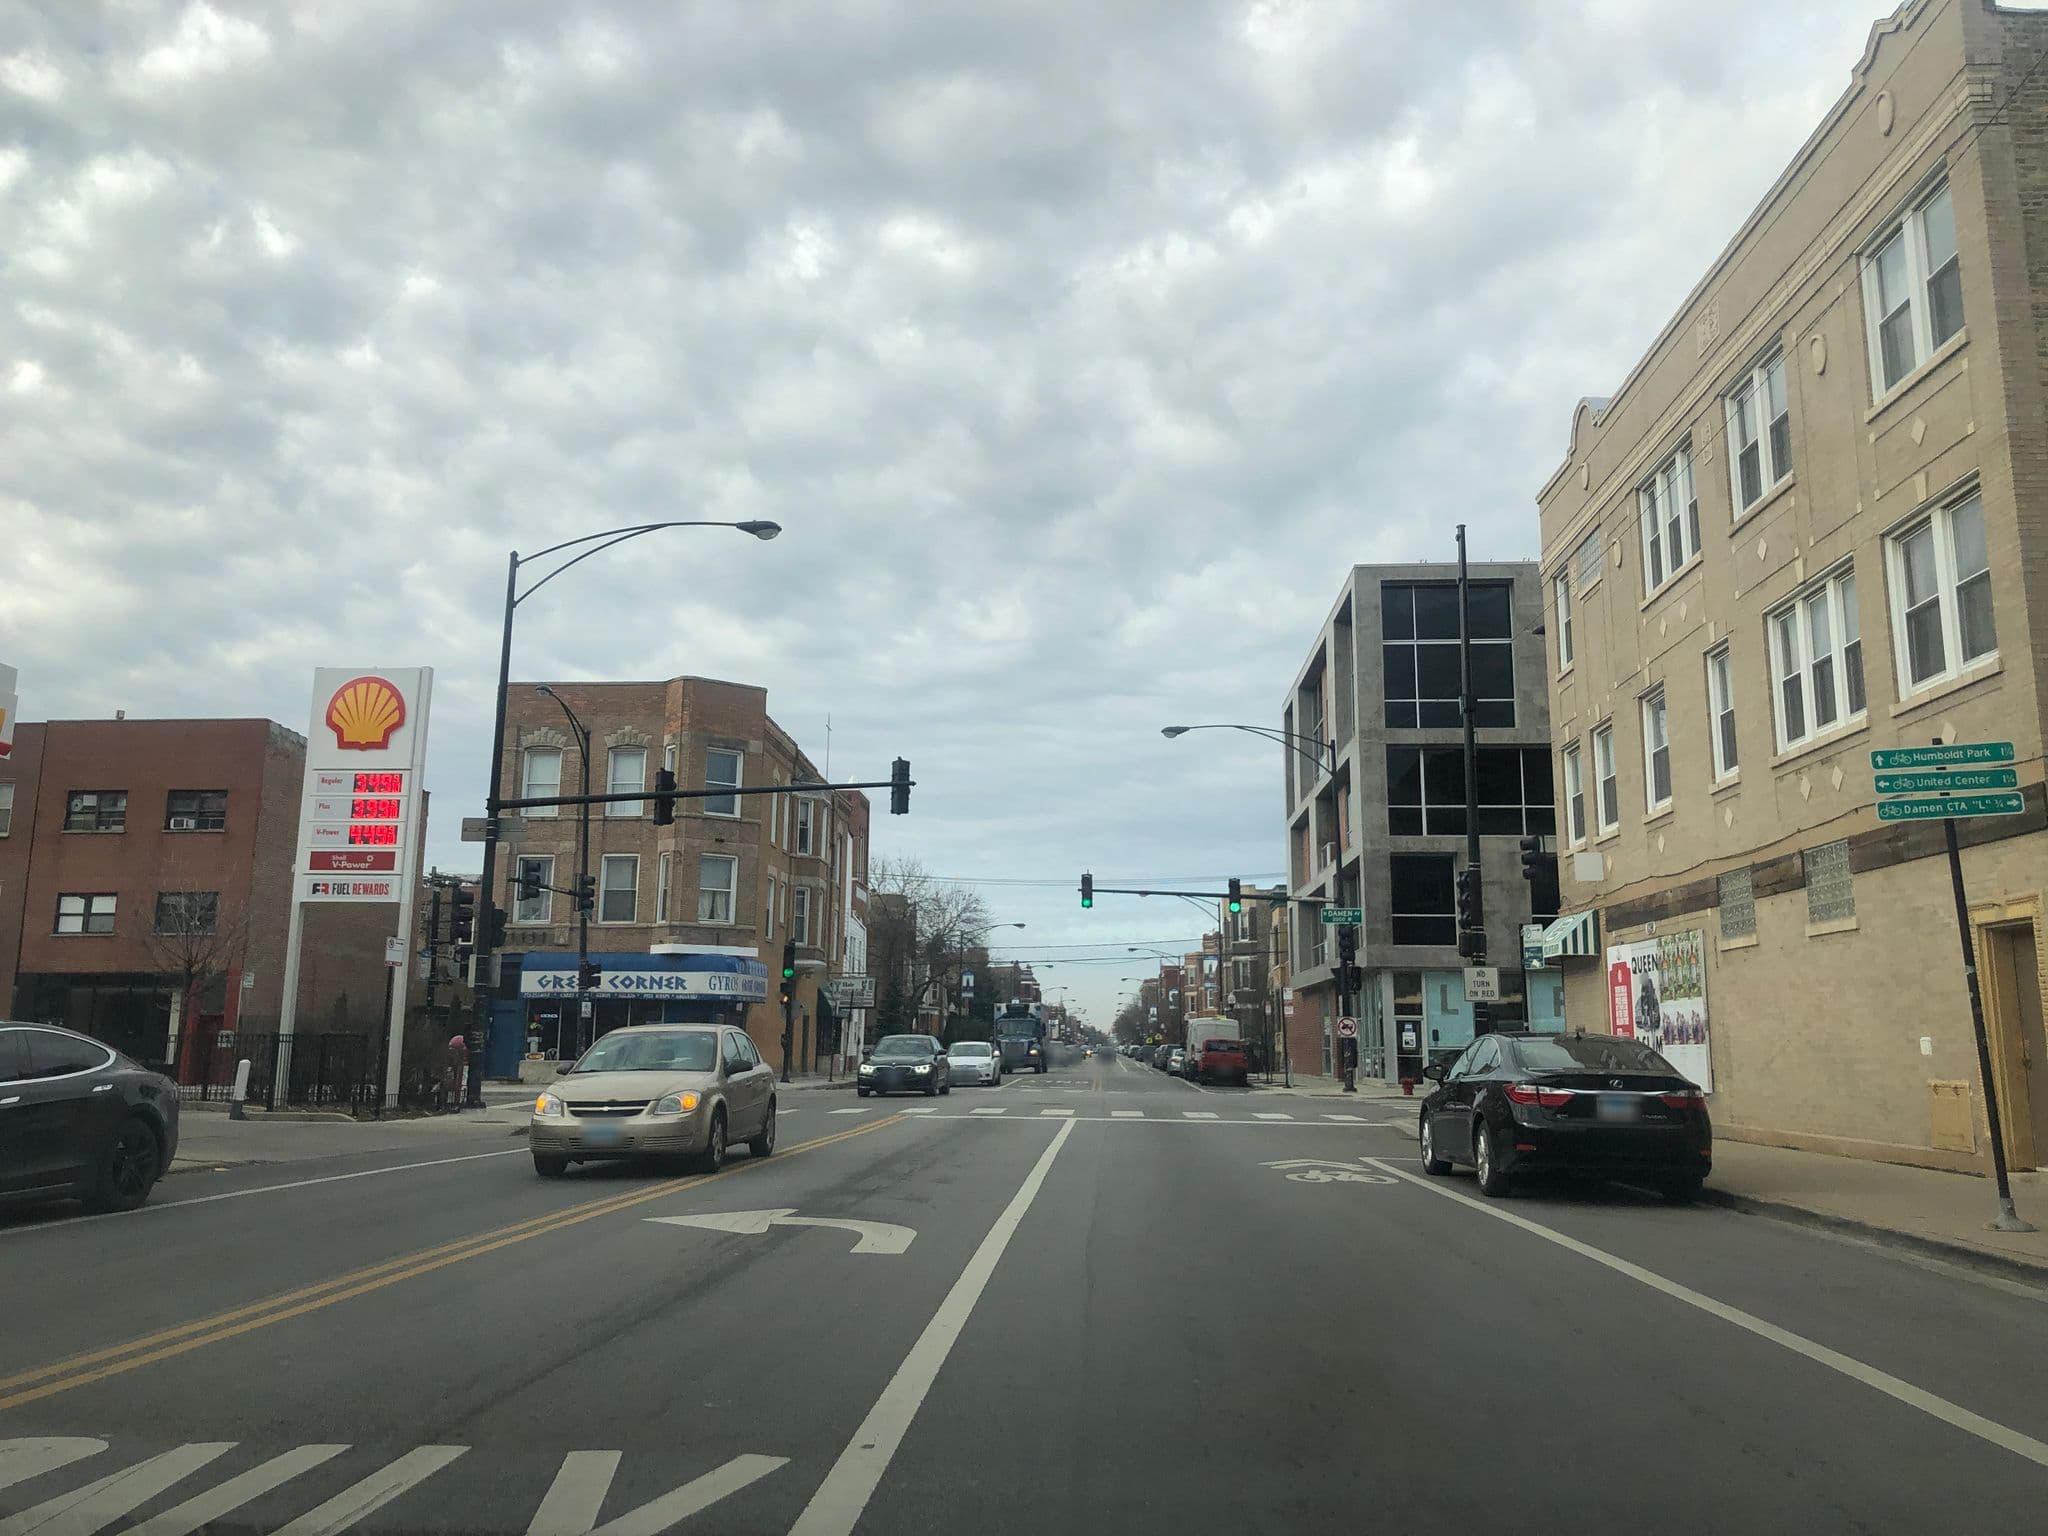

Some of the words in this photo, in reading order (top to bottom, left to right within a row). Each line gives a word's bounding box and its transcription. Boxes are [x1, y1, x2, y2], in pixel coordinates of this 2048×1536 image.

[1913, 749, 1964, 762] Humboldt
[1967, 748, 1991, 758] Park
[320, 776, 343, 785] Regular
[1916, 776, 1951, 787] United
[1955, 775, 1990, 786] Center
[318, 802, 331, 810] Plus
[1904, 802, 1943, 815] Damen
[1947, 801, 1968, 812] CTA
[1972, 799, 1991, 810] "L"
[316, 828, 339, 836] V-Power
[332, 860, 371, 869] V-Power
[332, 882, 351, 896] FUEL
[352, 882, 390, 896] REWARDS
[1631, 953, 1659, 975] QUEEN
[1476, 970, 1486, 978] NO
[608, 974, 687, 991] CORNER
[1472, 980, 1490, 988] TURN
[1469, 990, 1479, 998] ON
[1481, 990, 1495, 998] RED
